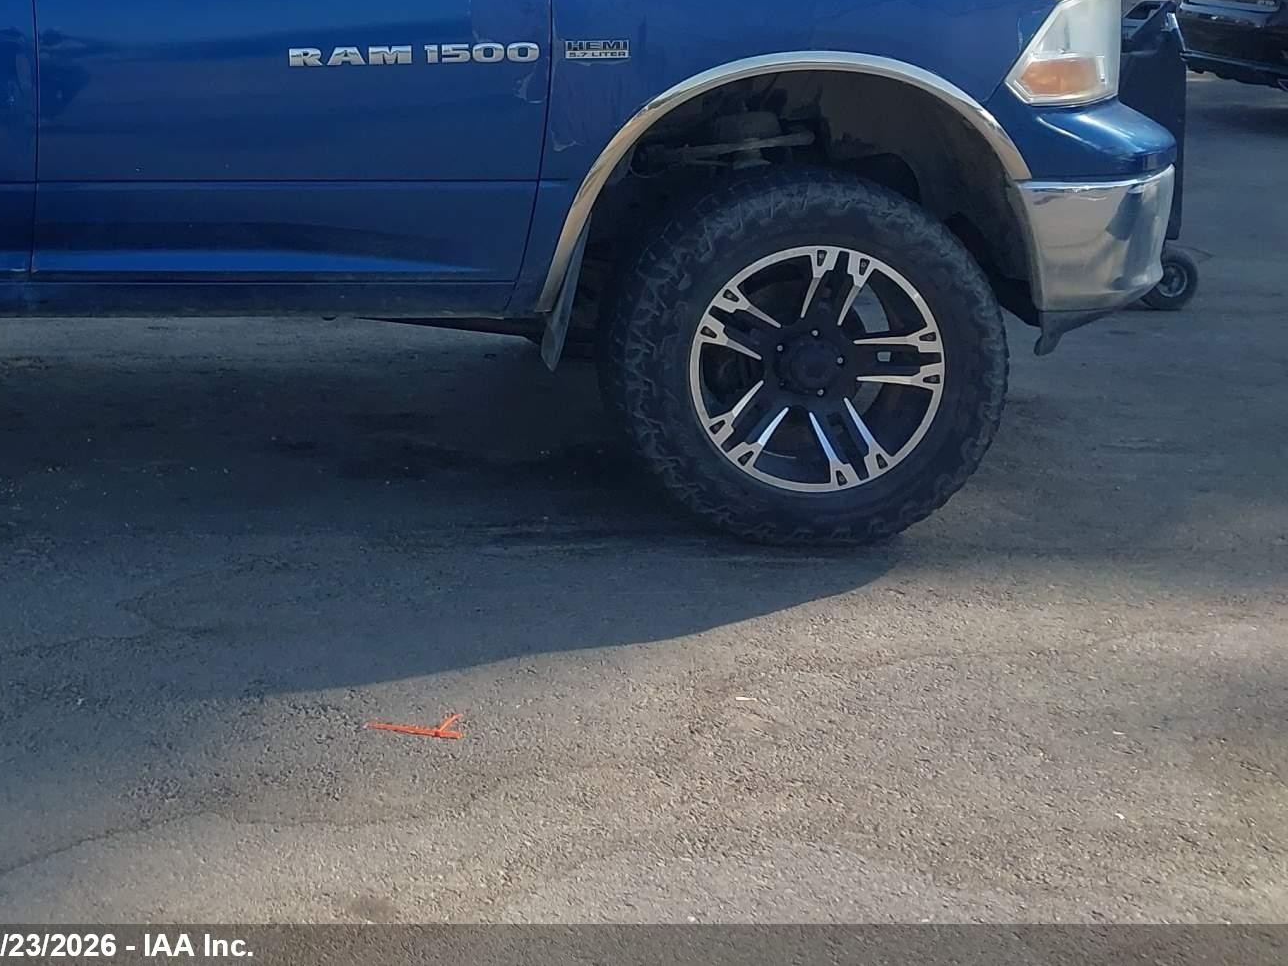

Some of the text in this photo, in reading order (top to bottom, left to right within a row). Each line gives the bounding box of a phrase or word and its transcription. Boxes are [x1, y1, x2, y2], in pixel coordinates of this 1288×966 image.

[288, 41, 540, 67] RAM 1500
[565, 40, 629, 51] HEMI
